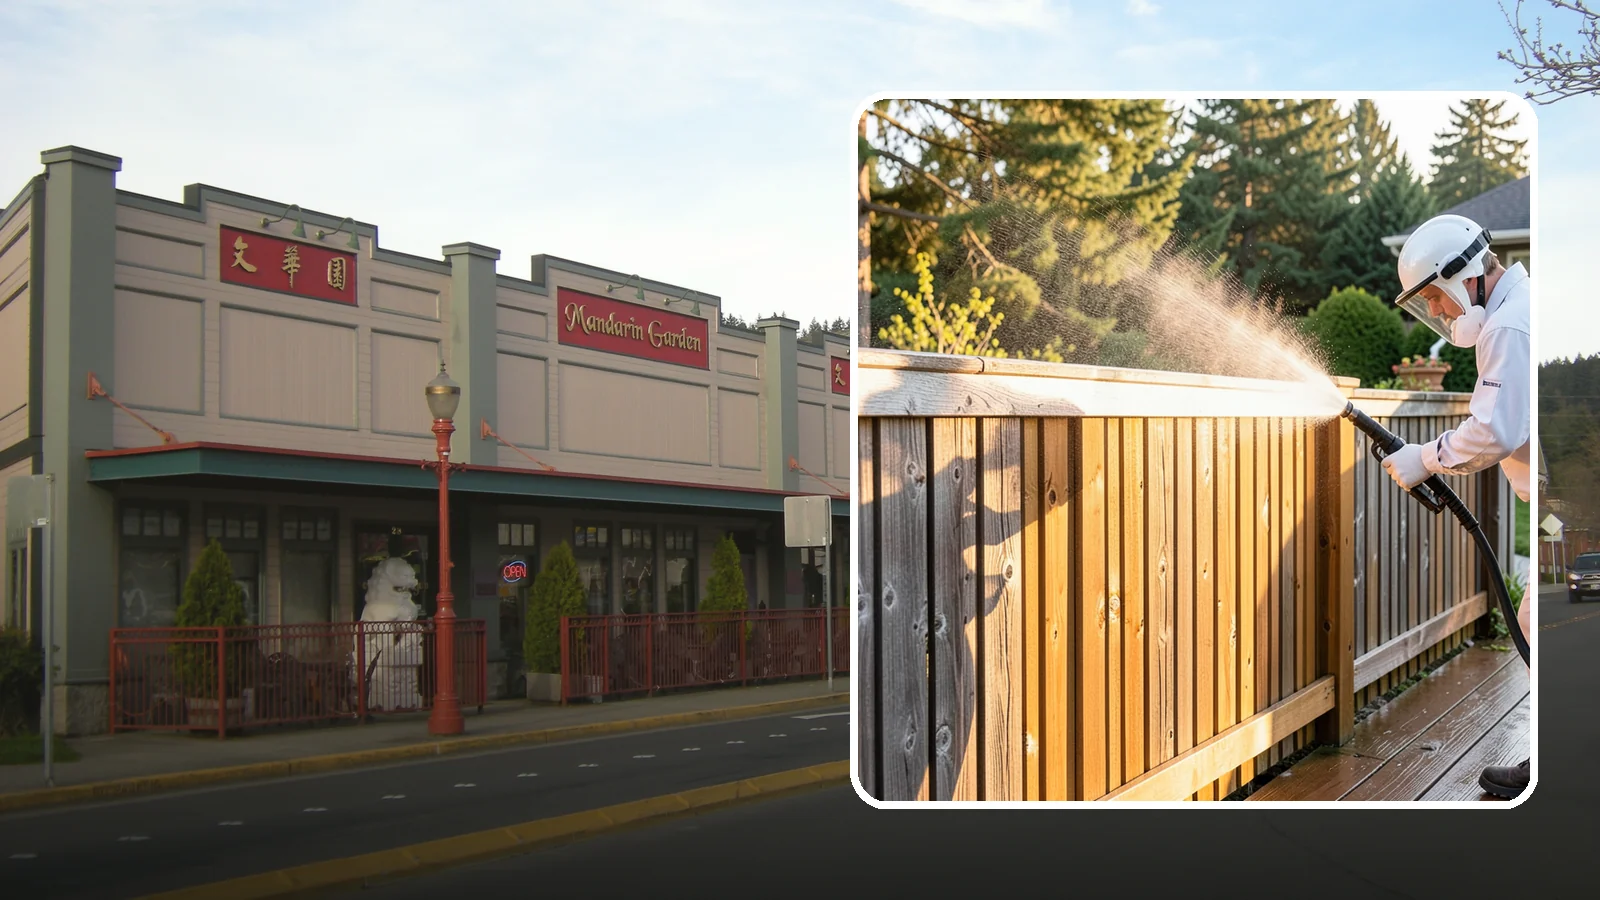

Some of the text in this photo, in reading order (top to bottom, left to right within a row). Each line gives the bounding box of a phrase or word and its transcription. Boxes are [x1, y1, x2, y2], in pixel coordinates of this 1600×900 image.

[231, 235, 346, 291] 文華園
[564, 302, 702, 352] Mandarin Garden
[503, 565, 527, 578] OPEN
